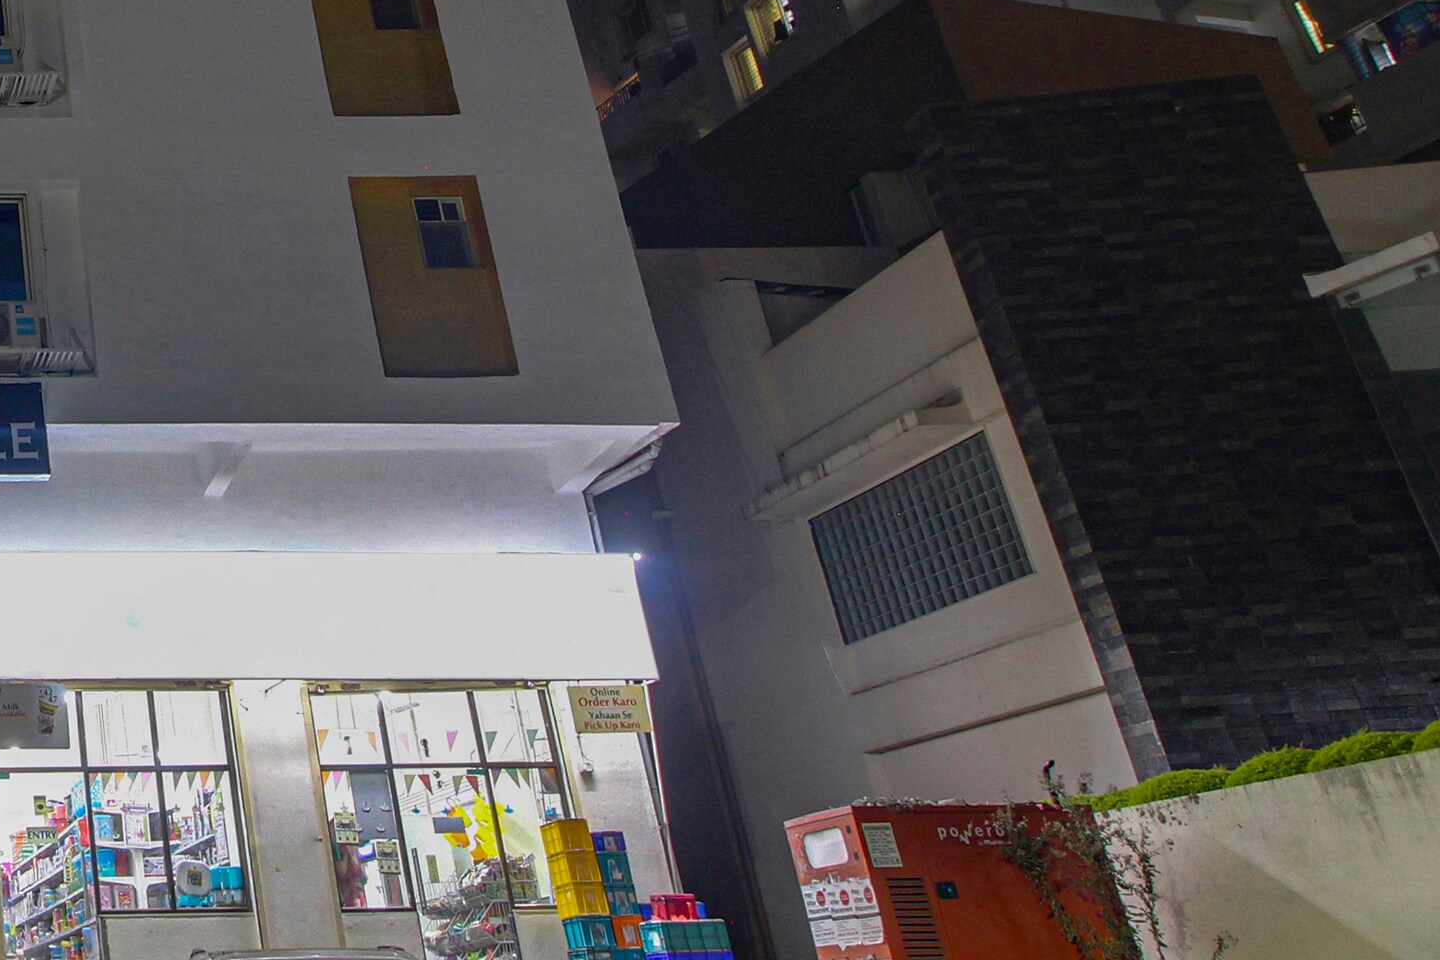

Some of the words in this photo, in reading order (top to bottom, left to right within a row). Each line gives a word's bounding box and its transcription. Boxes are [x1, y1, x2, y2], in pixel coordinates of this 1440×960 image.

[590, 687, 621, 696] Online
[3, 703, 20, 711] Milk
[578, 697, 610, 707] Order
[612, 697, 637, 707] Karo
[588, 710, 621, 720] Yahaan
[622, 710, 633, 719] Se
[584, 721, 603, 730] Pick
[605, 721, 619, 732] Up
[620, 721, 641, 730] Karo
[28, 830, 57, 840] ENTRY
